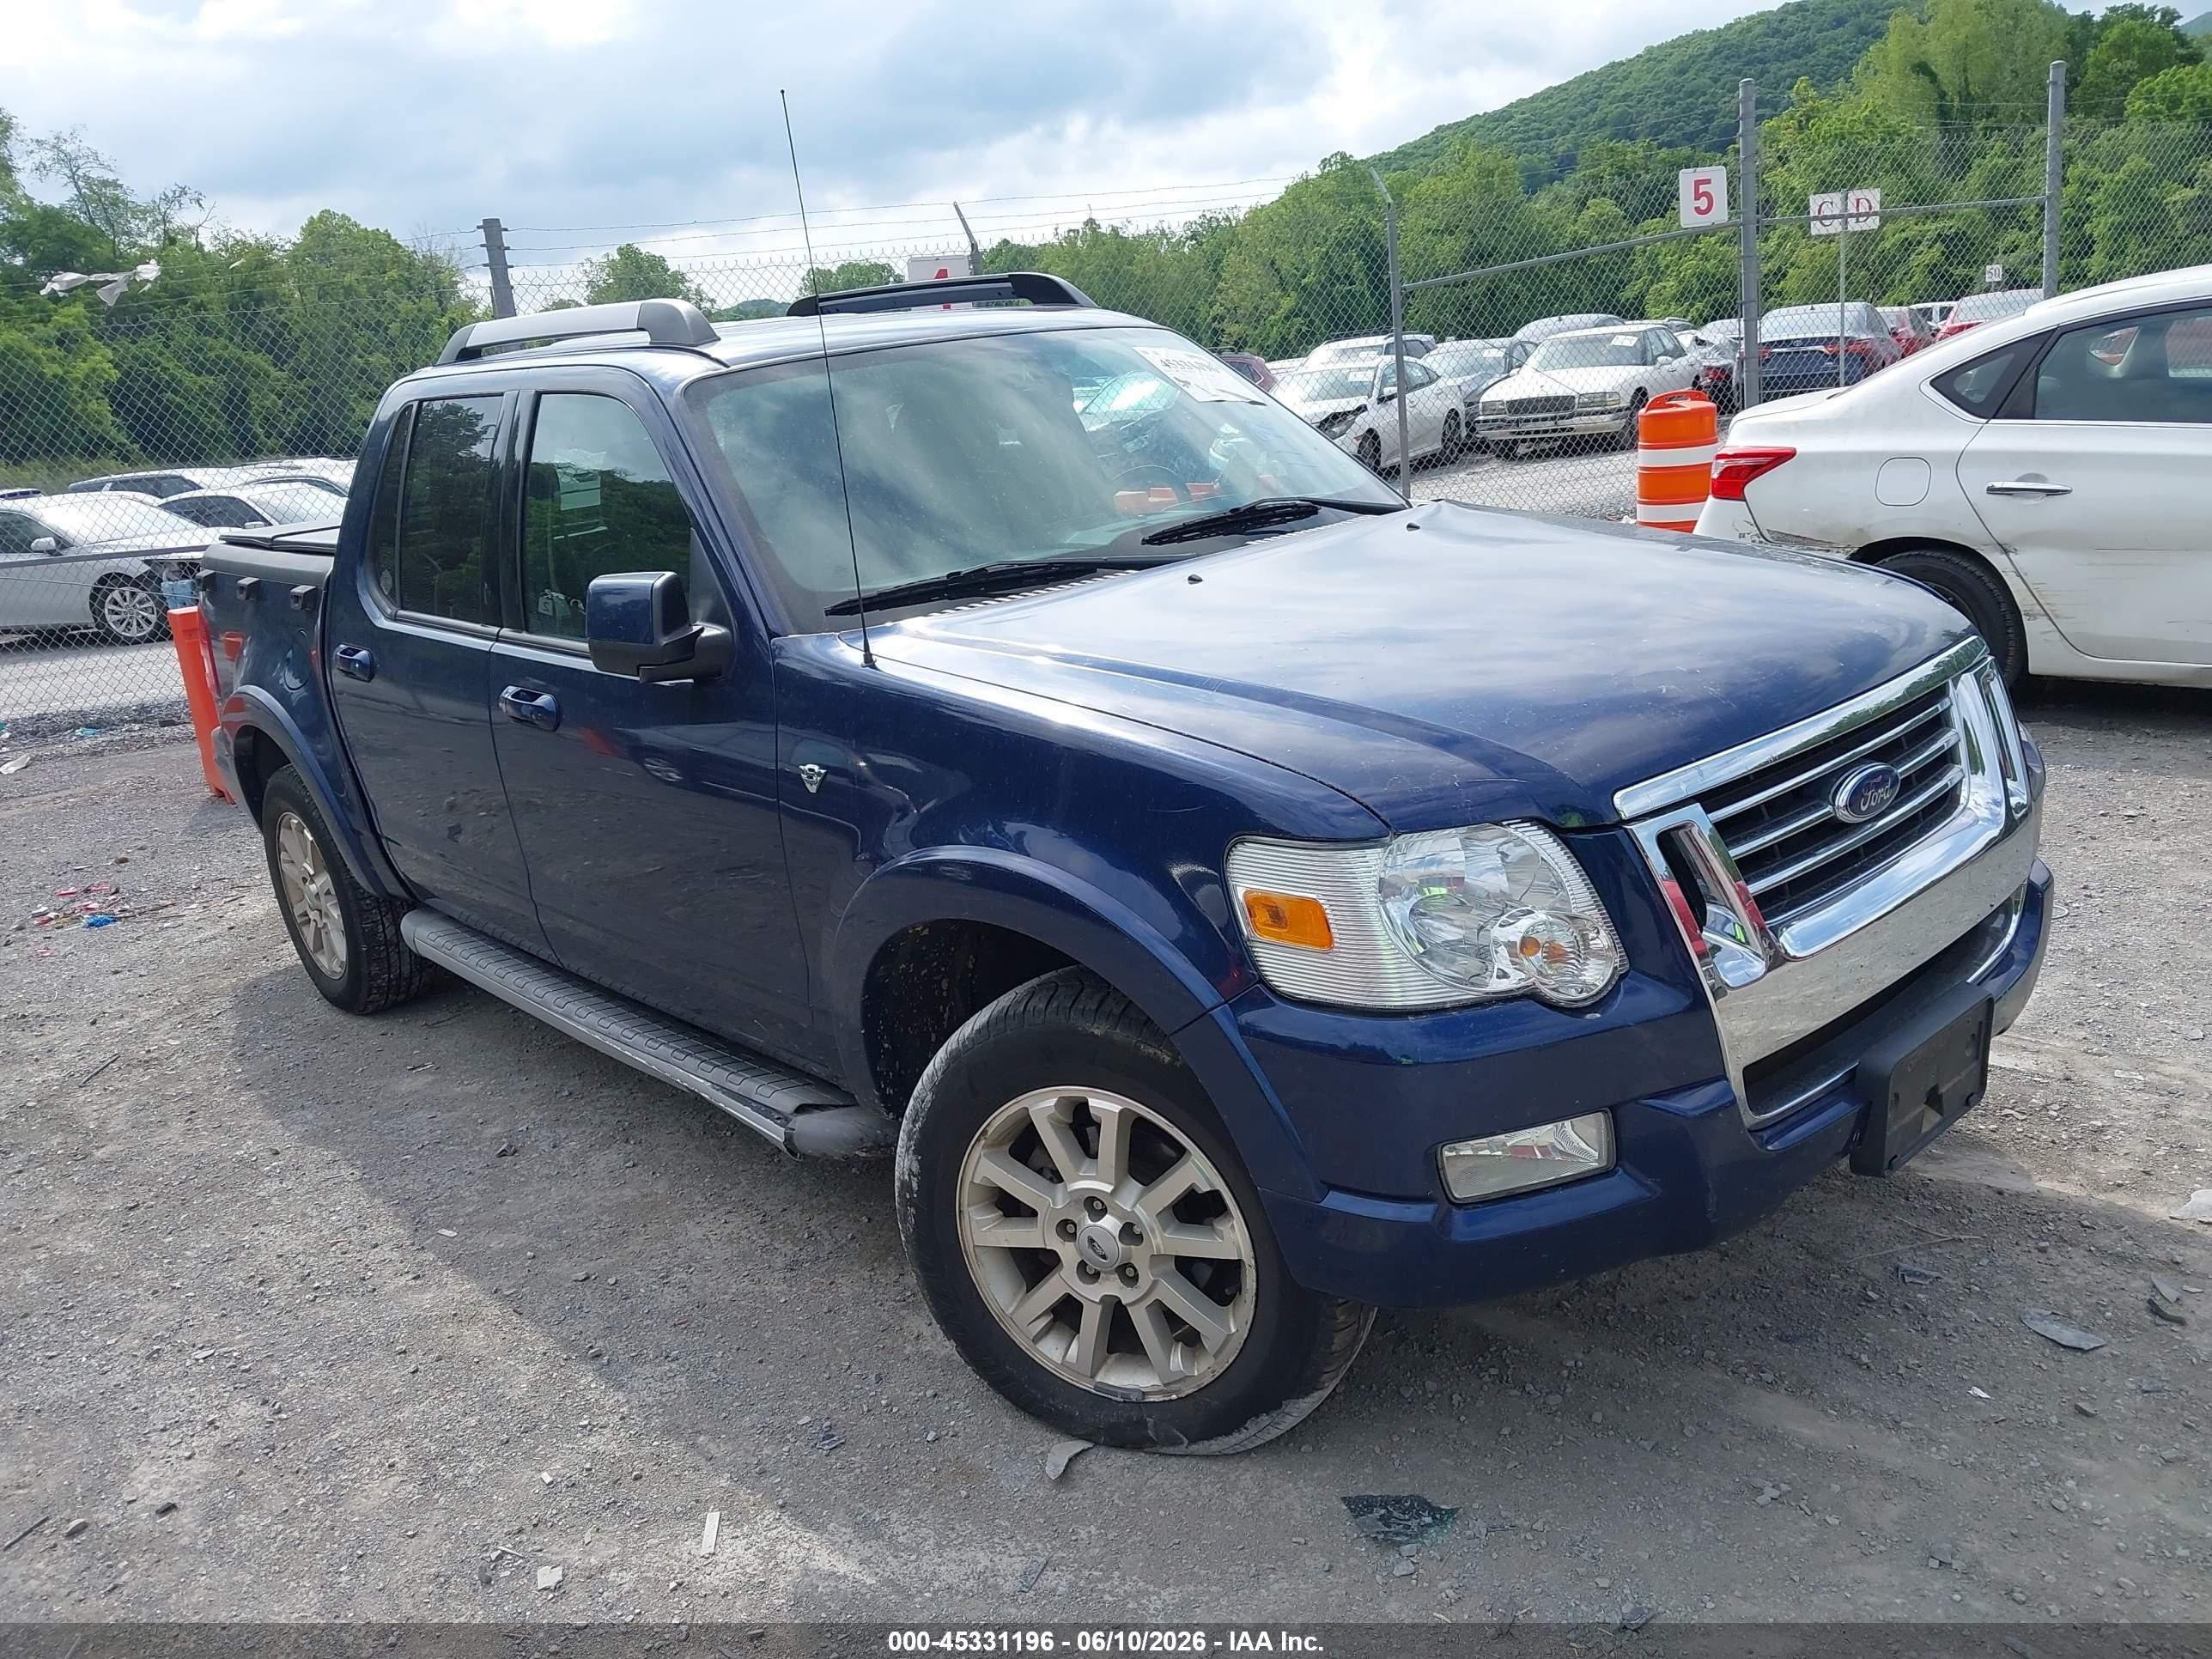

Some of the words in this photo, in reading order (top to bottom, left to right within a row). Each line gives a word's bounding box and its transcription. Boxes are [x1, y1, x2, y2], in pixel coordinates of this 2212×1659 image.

[1692, 178, 1715, 216] 5
[1853, 197, 1873, 224] D
[1816, 199, 1834, 228] C
[1159, 357, 1221, 374] 45331
[1859, 774, 1893, 812] Ford
